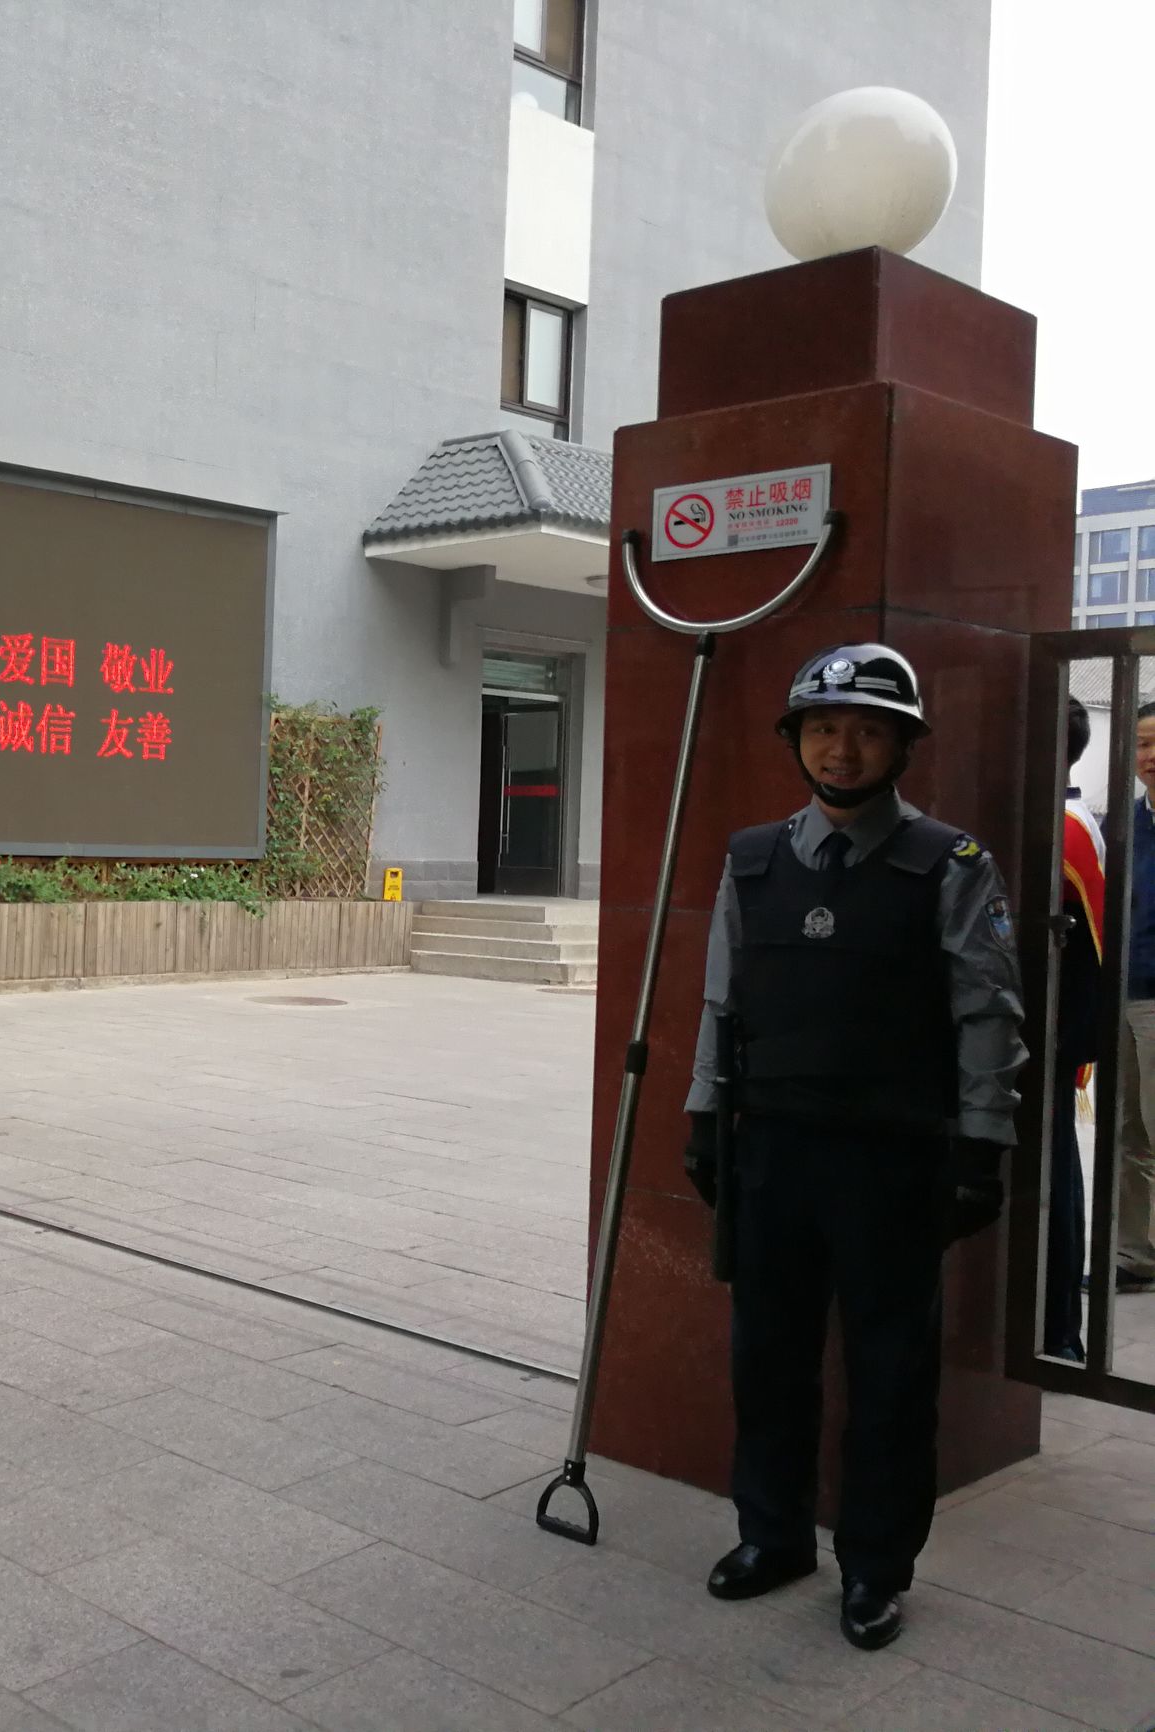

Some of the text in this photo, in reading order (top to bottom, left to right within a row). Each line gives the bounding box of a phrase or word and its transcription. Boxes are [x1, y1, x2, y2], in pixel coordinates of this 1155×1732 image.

[724, 477, 813, 511] 禁止吸烟
[728, 502, 809, 522] NO SMOKING
[99, 641, 175, 695] 敬业
[96, 708, 173, 761] 友善
